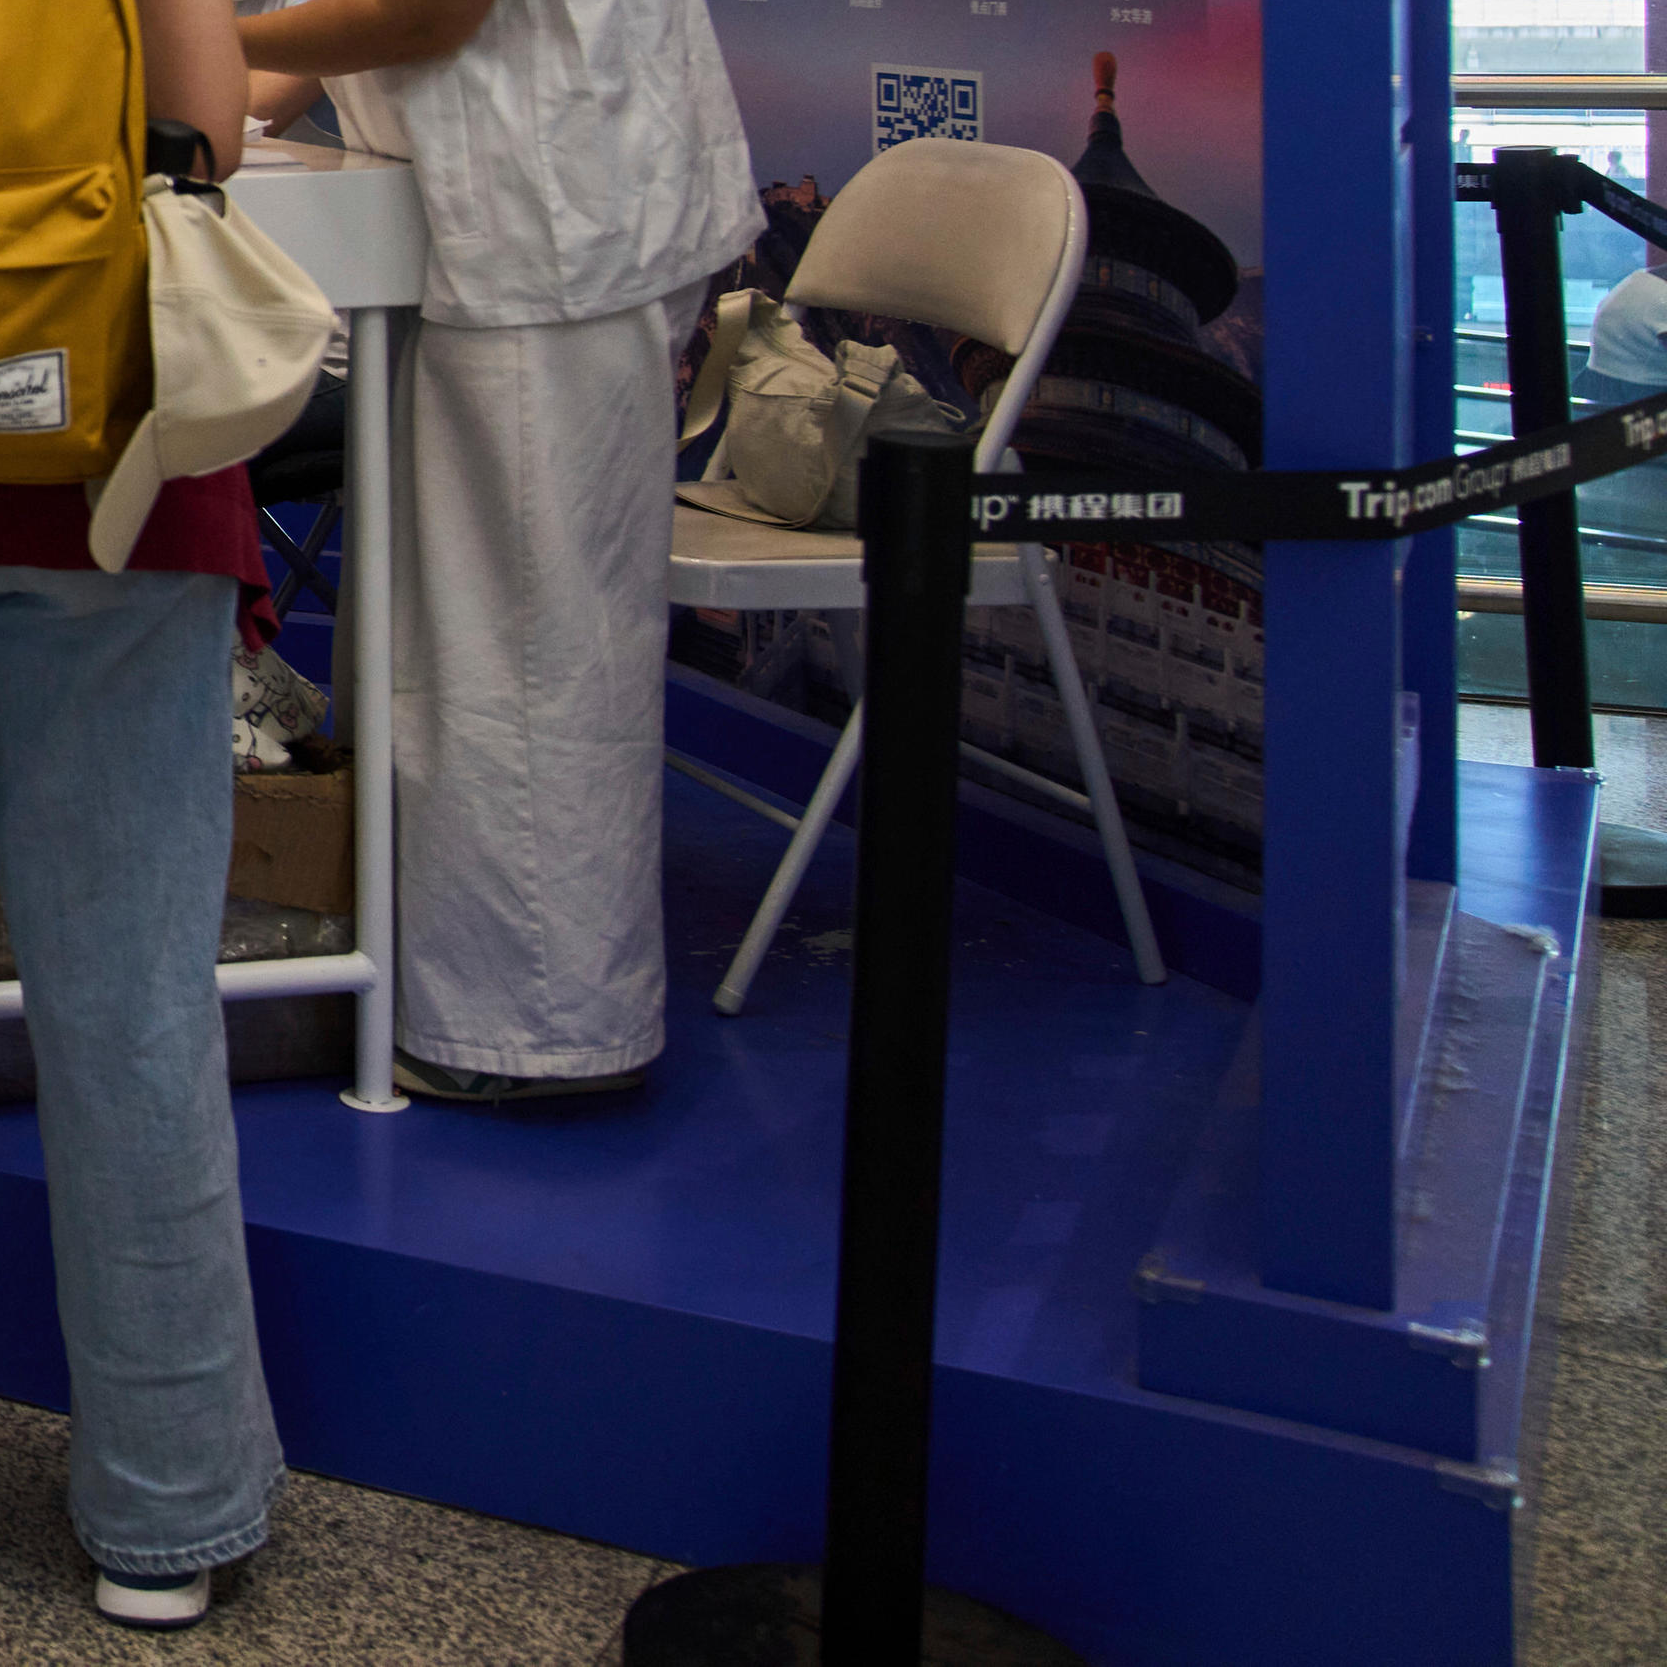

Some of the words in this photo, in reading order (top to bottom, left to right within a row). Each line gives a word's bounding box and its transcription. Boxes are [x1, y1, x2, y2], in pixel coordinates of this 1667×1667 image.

[1026, 491, 1184, 520] 携程集团
[1340, 476, 1453, 527] Trip.com
